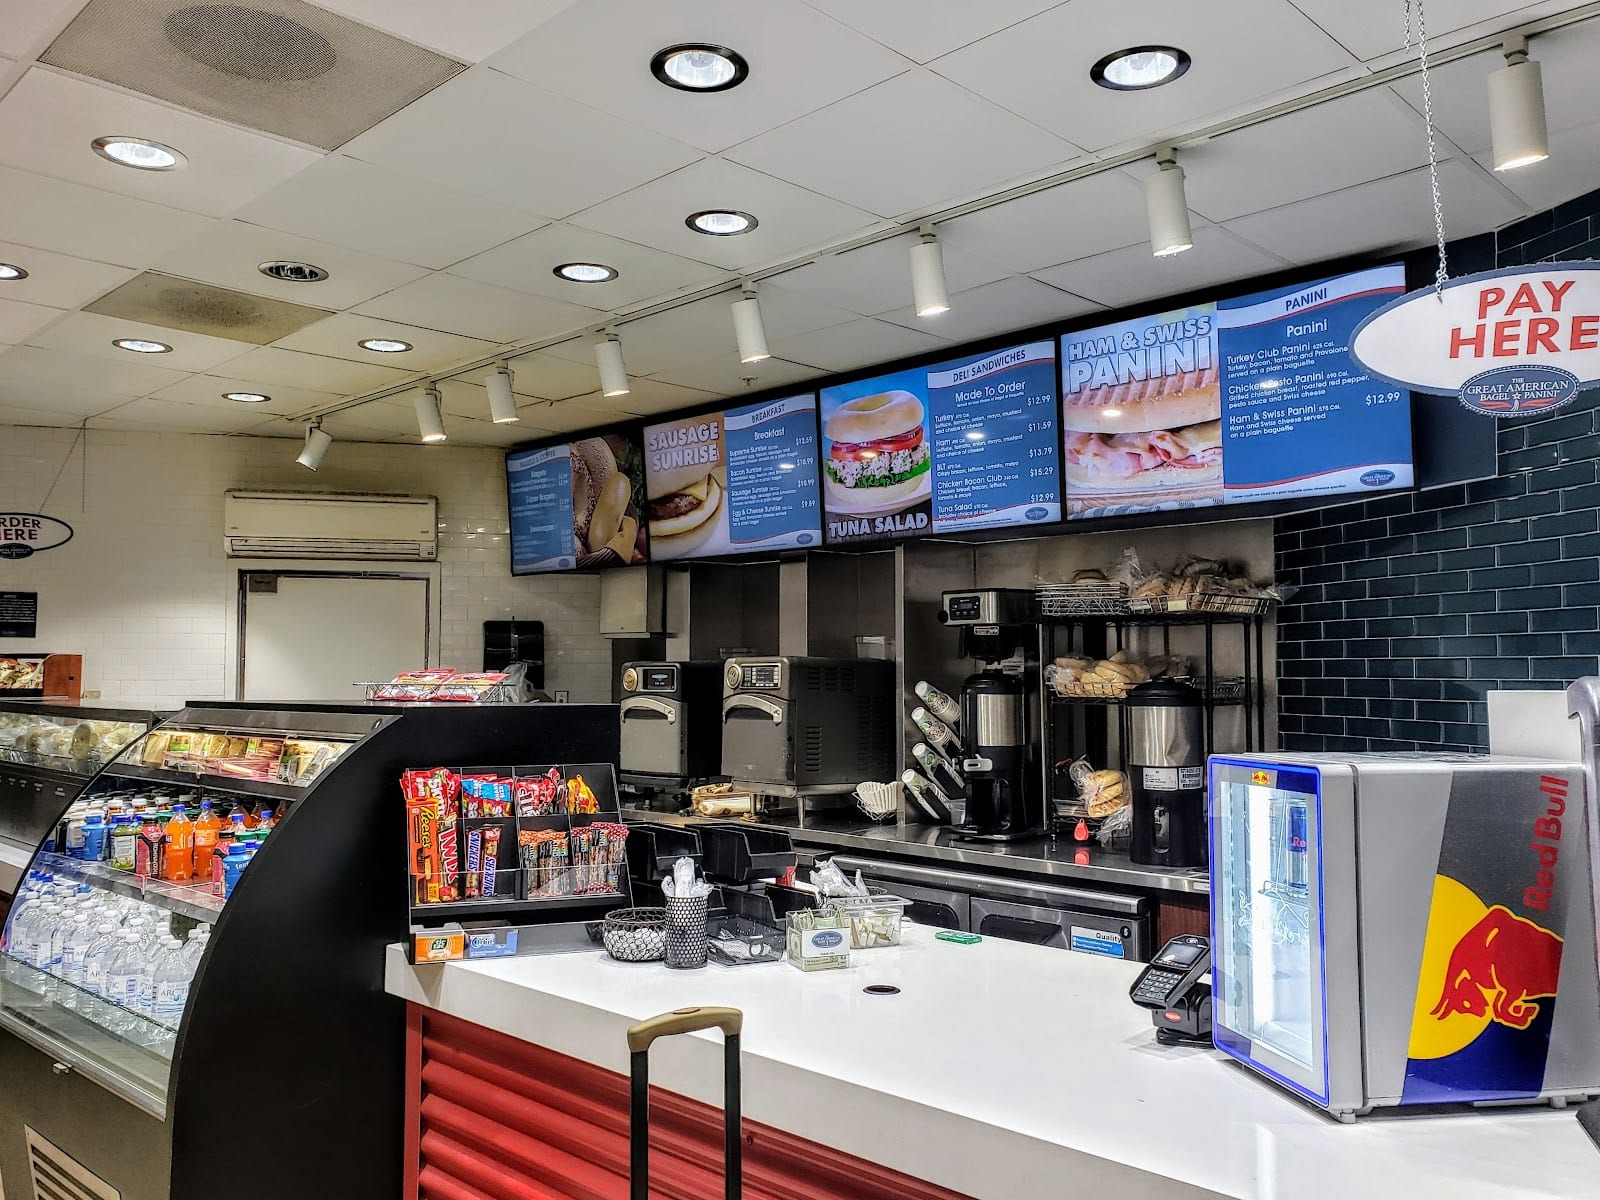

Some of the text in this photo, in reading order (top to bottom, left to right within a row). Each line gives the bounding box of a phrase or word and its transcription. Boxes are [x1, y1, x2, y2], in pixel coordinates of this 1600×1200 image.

[1286, 288, 1327, 311] PANINI
[1478, 281, 1576, 319] PAY
[1287, 319, 1328, 337] Panini
[1450, 316, 1600, 358] HERE
[1068, 316, 1211, 362] HAM & SWISS
[1227, 354, 1254, 365] Turkey
[1258, 348, 1279, 359] Club
[1283, 342, 1310, 354] Panini
[1250, 360, 1272, 368] bacon,
[1275, 355, 1298, 364] tomato
[1315, 347, 1348, 356] Provolone
[954, 352, 1026, 382] DELI SANDWICHES
[1070, 336, 1212, 393] PANINI
[1228, 370, 1248, 379] served
[1266, 364, 1282, 374] plain
[1284, 359, 1315, 370] baguette
[1229, 381, 1266, 394] Chicken
[1296, 371, 1324, 383] Panini
[1229, 394, 1249, 402] Grilled
[1251, 390, 1276, 398] chicken
[1278, 385, 1300, 394] breast,
[1302, 382, 1326, 390] roasted
[1342, 375, 1370, 385] pepper,
[1468, 381, 1569, 394] GREAT AMERICAN
[956, 390, 982, 402] Made
[986, 387, 995, 396] To
[998, 382, 1026, 393] Order
[1028, 395, 1051, 406] $12.99
[1301, 389, 1326, 397] cheese
[1366, 392, 1400, 407] $12.99
[1525, 390, 1558, 398] PANINI
[752, 404, 785, 423] BREAKFAST
[936, 415, 954, 423] Turkey
[1230, 415, 1250, 424] Ham
[1254, 413, 1260, 421] &
[1263, 410, 1285, 419] Swiss
[1288, 404, 1316, 416] Panini
[1304, 413, 1326, 421] served
[754, 427, 784, 440] Breakfast
[1029, 421, 1051, 432] $11.59
[1246, 429, 1262, 437] plain
[1264, 425, 1293, 434] baguette
[650, 422, 719, 451] SAUSAGE
[653, 444, 719, 472] SUNRISE
[1029, 447, 1052, 458] $13.79
[937, 463, 945, 471] BLT
[1030, 467, 1053, 478] $15.29
[938, 480, 962, 489] Chicken
[965, 477, 984, 486] Bacon
[987, 474, 1002, 482] Club
[1031, 493, 1054, 503] $12.99
[955, 503, 972, 512] Salad
[0, 517, 41, 529] RDER
[829, 519, 871, 537] TUNA
[875, 513, 928, 533] SALAD
[0, 529, 38, 540] ERE
[420, 807, 434, 848] Reese's
[1293, 837, 1306, 847] Re
[1523, 775, 1569, 910] Red Bull
[438, 822, 458, 883] TWIX
[469, 832, 480, 872] SNICKERS
[483, 856, 496, 897] SNICKERS
[1096, 932, 1120, 943] Quality
[161, 987, 188, 996] ARCTI
